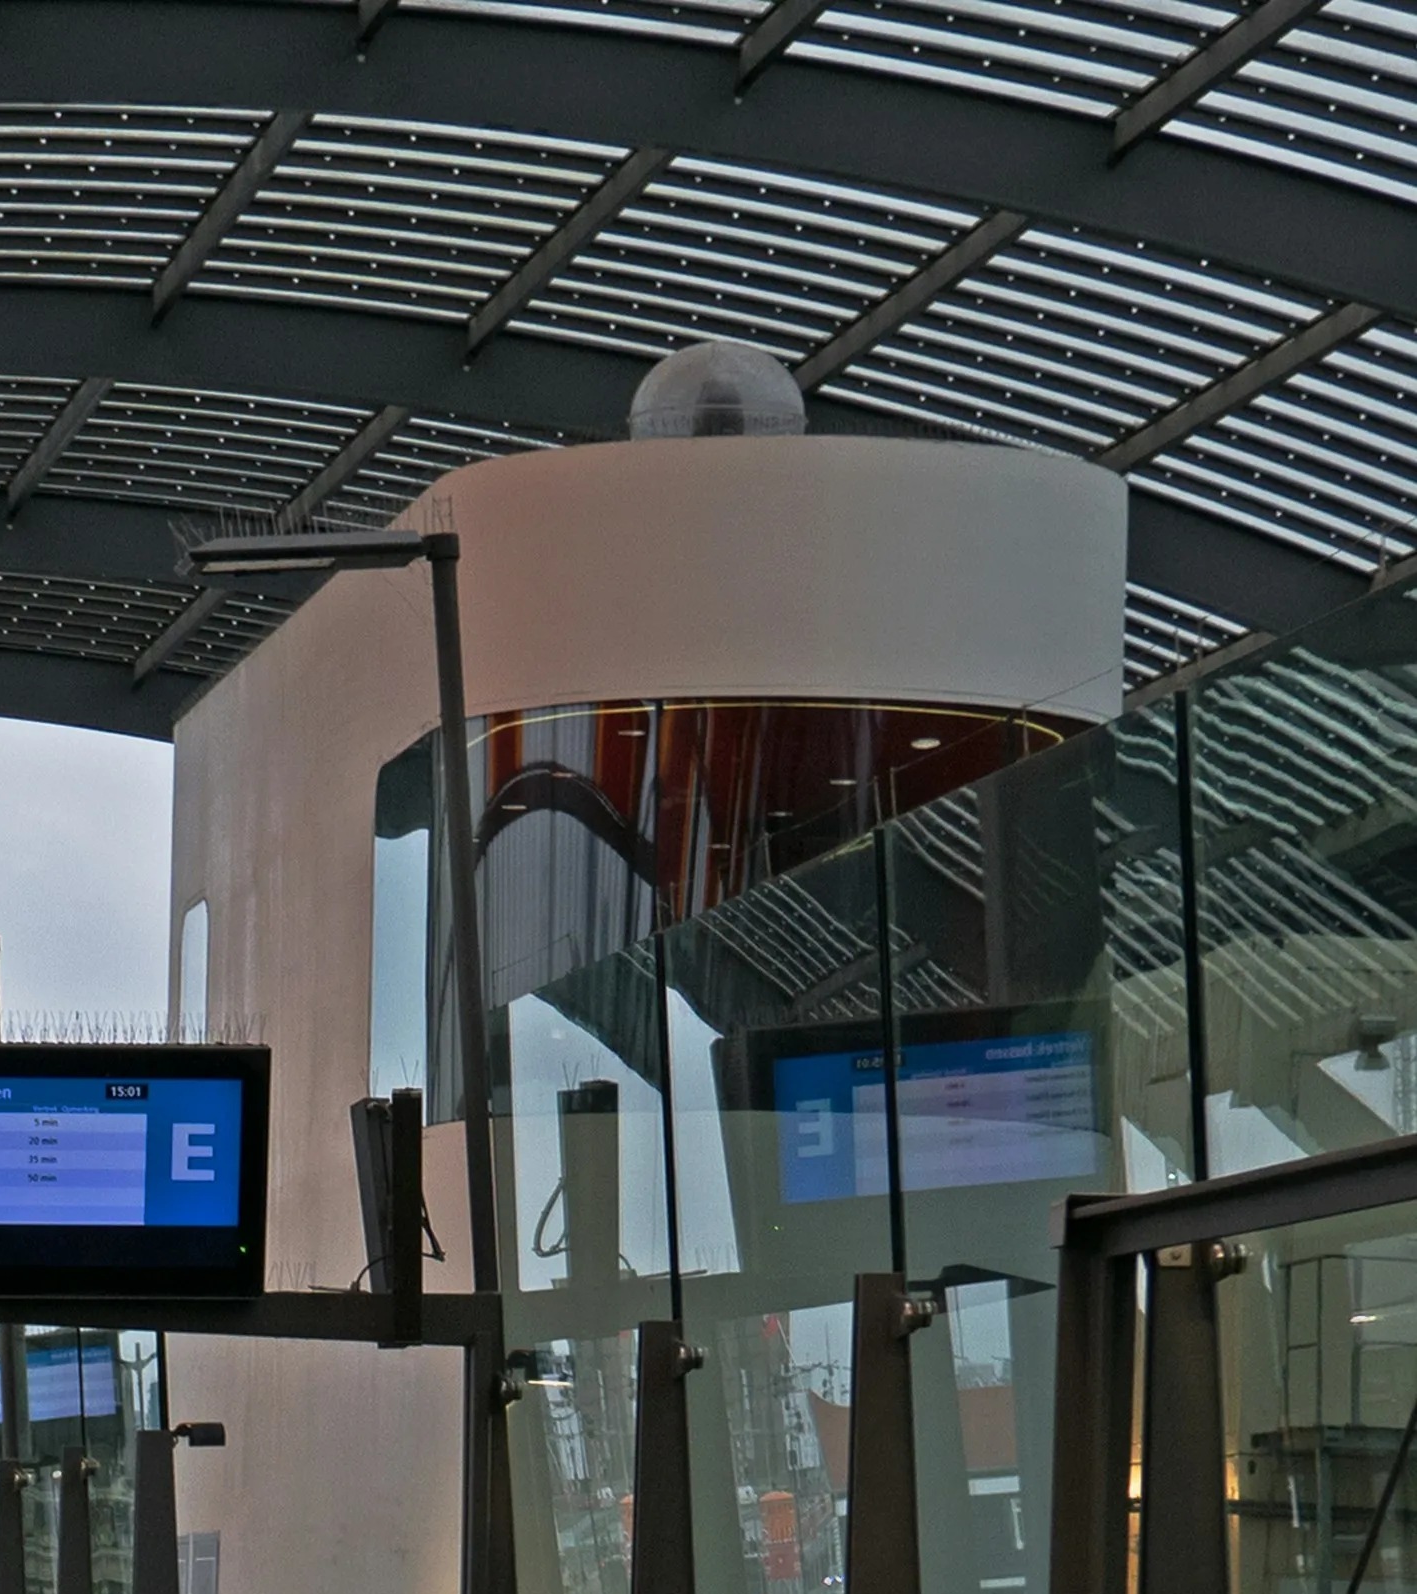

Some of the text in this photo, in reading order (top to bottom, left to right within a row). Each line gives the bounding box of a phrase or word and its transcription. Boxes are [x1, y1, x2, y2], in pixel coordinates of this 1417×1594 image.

[111, 1086, 141, 1097] 15:01
[34, 1118, 40, 1126] 5
[41, 1118, 58, 1126] min
[28, 1136, 40, 1146] 20
[41, 1137, 58, 1145] min
[172, 1123, 216, 1181] E
[29, 1155, 39, 1164] 35
[27, 1173, 39, 1182] 50
[40, 1174, 57, 1182] min
